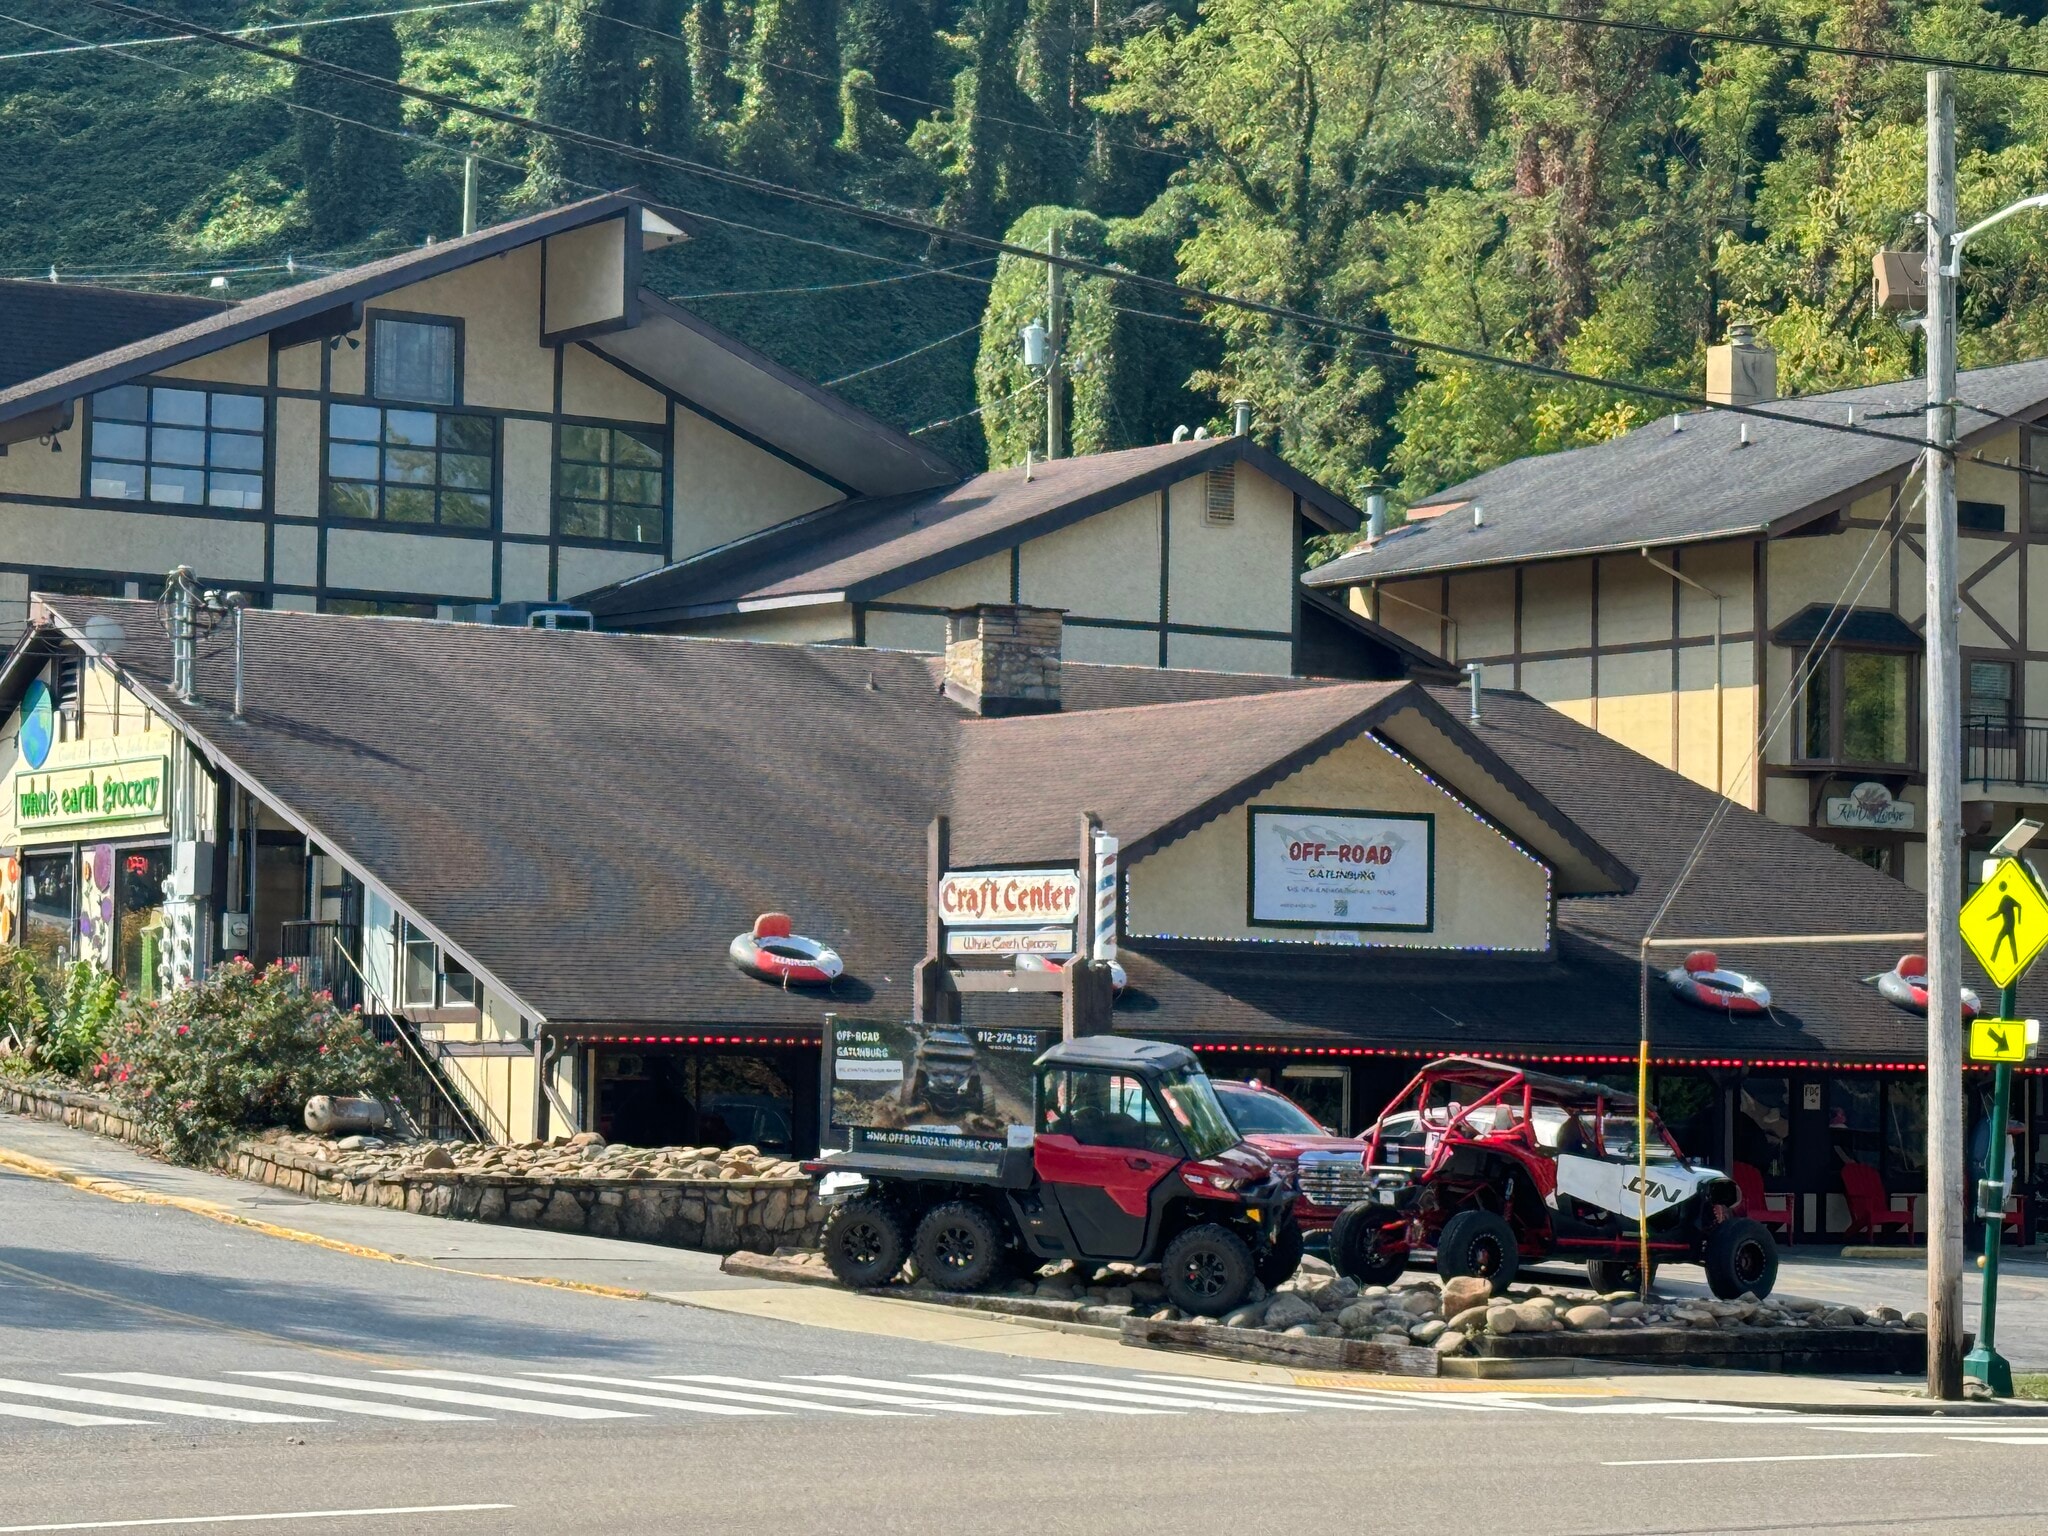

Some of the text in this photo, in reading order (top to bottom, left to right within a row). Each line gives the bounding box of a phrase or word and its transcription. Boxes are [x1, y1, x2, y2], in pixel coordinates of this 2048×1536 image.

[20, 770, 159, 819] whole earth grocery
[1289, 842, 1392, 865] OFF-ROAD
[1308, 869, 1376, 881] GATLINBURG
[942, 878, 1076, 919] Craft Center
[836, 1031, 880, 1042] OFF-ROAD
[836, 1046, 889, 1058] GATLINBURG
